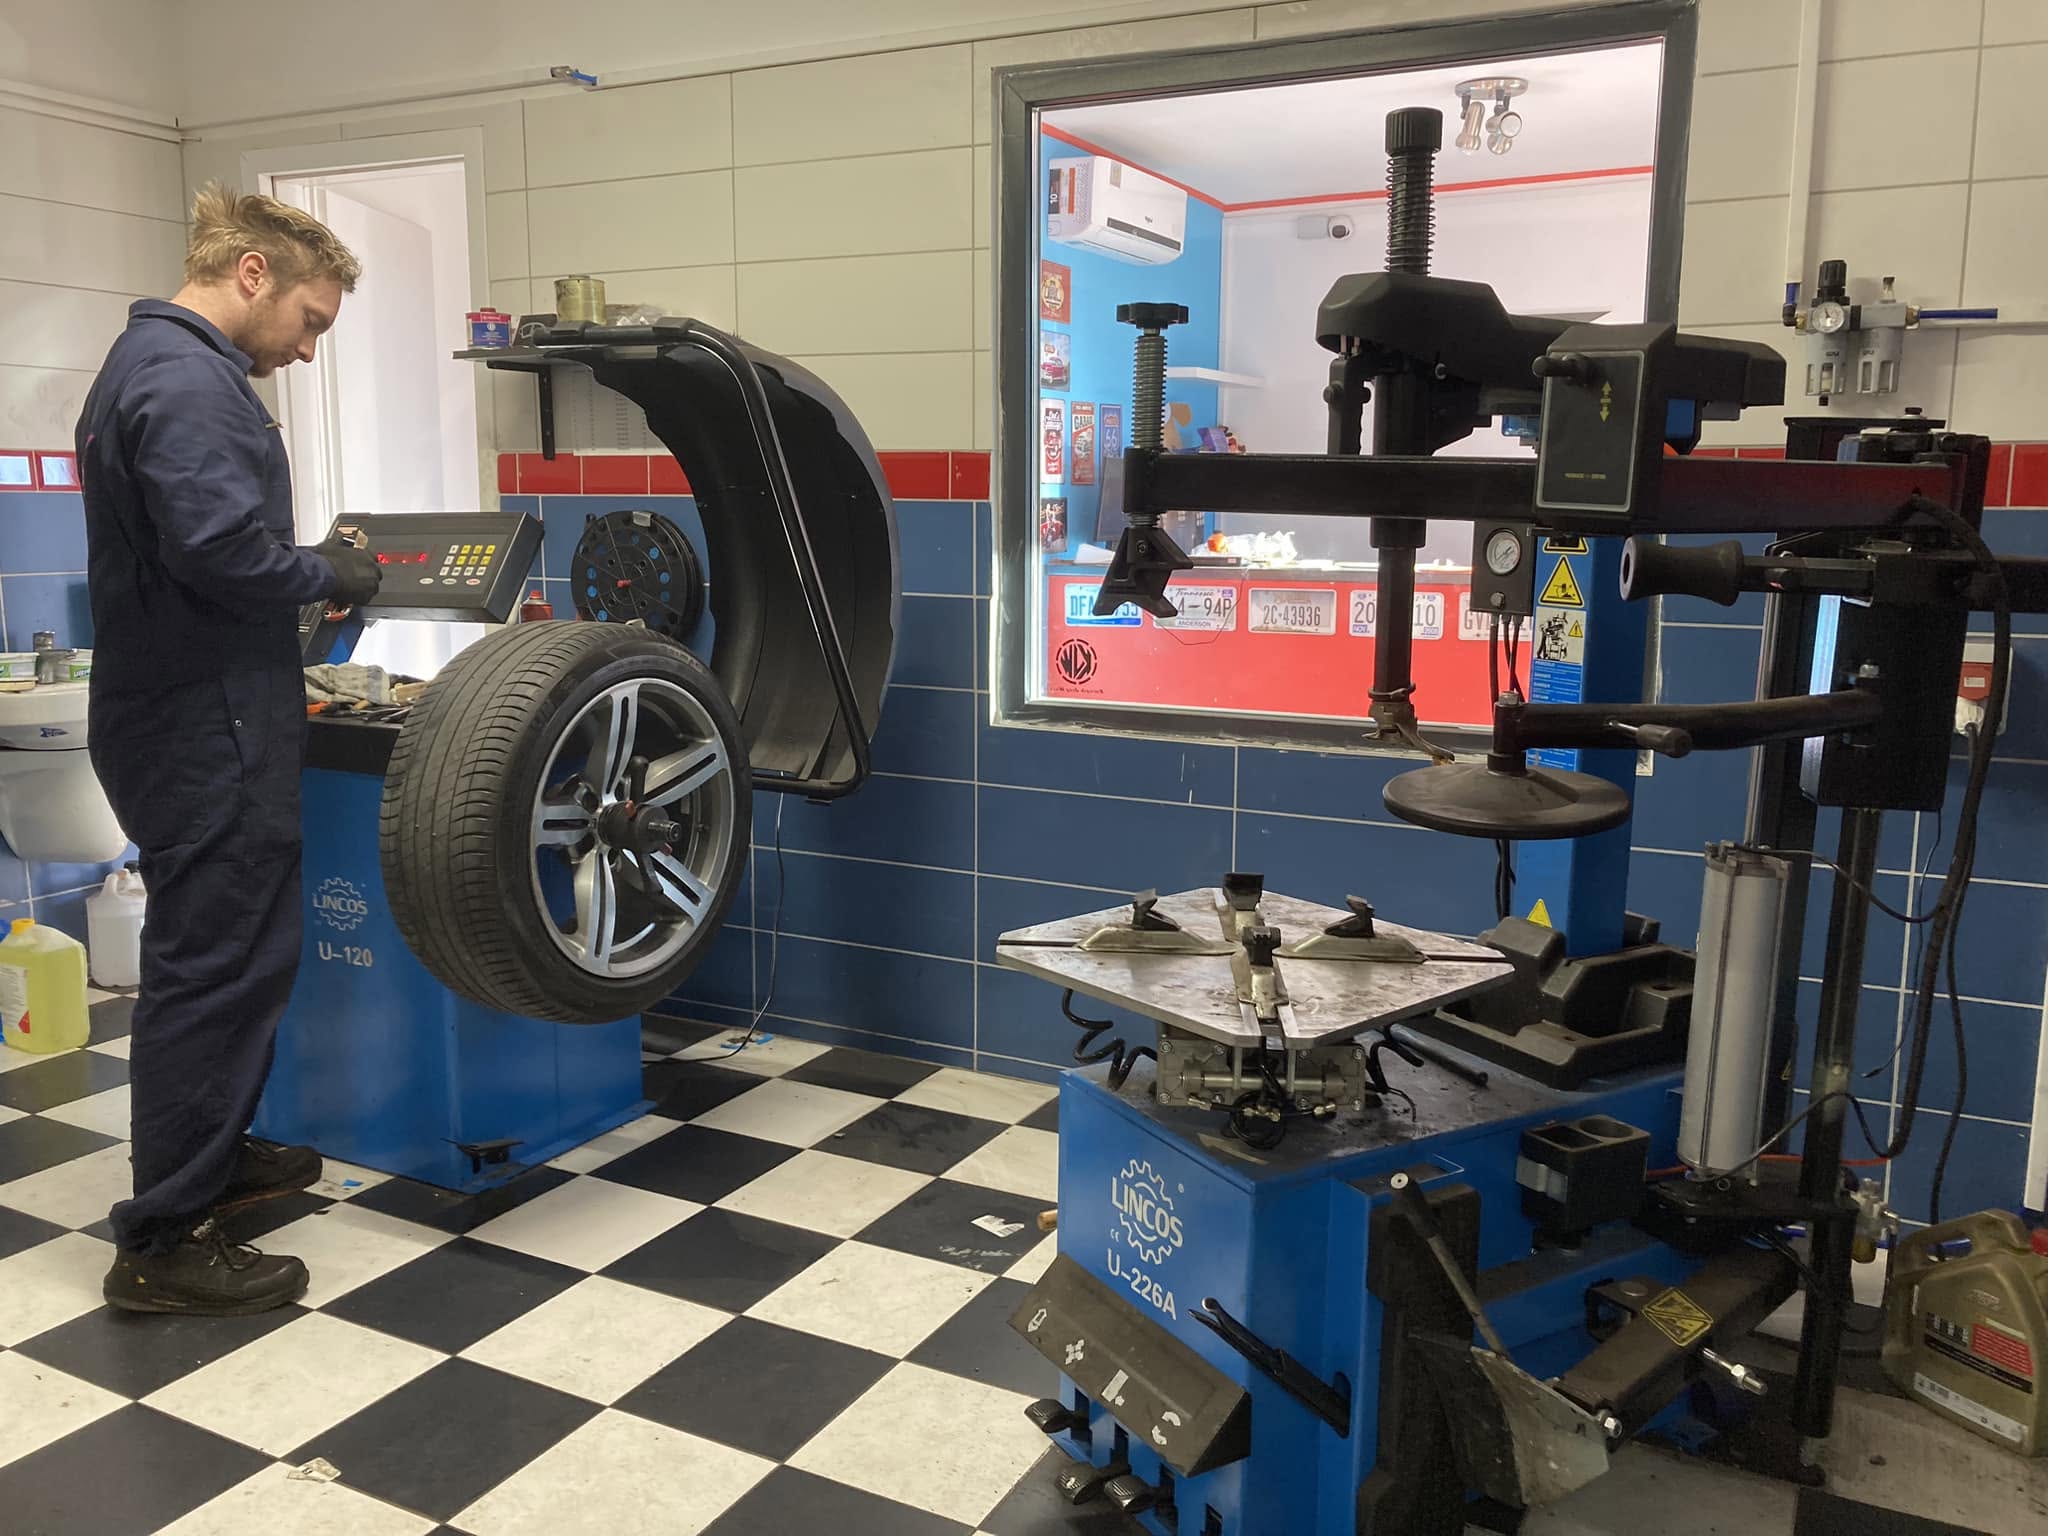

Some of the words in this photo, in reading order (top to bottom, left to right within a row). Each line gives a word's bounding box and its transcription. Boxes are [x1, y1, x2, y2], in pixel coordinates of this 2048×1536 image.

[311, 892, 368, 916] LINCOS
[318, 940, 373, 968] U-120
[1111, 1175, 1184, 1248] LINCOS
[1107, 1247, 1177, 1321] U-226A
